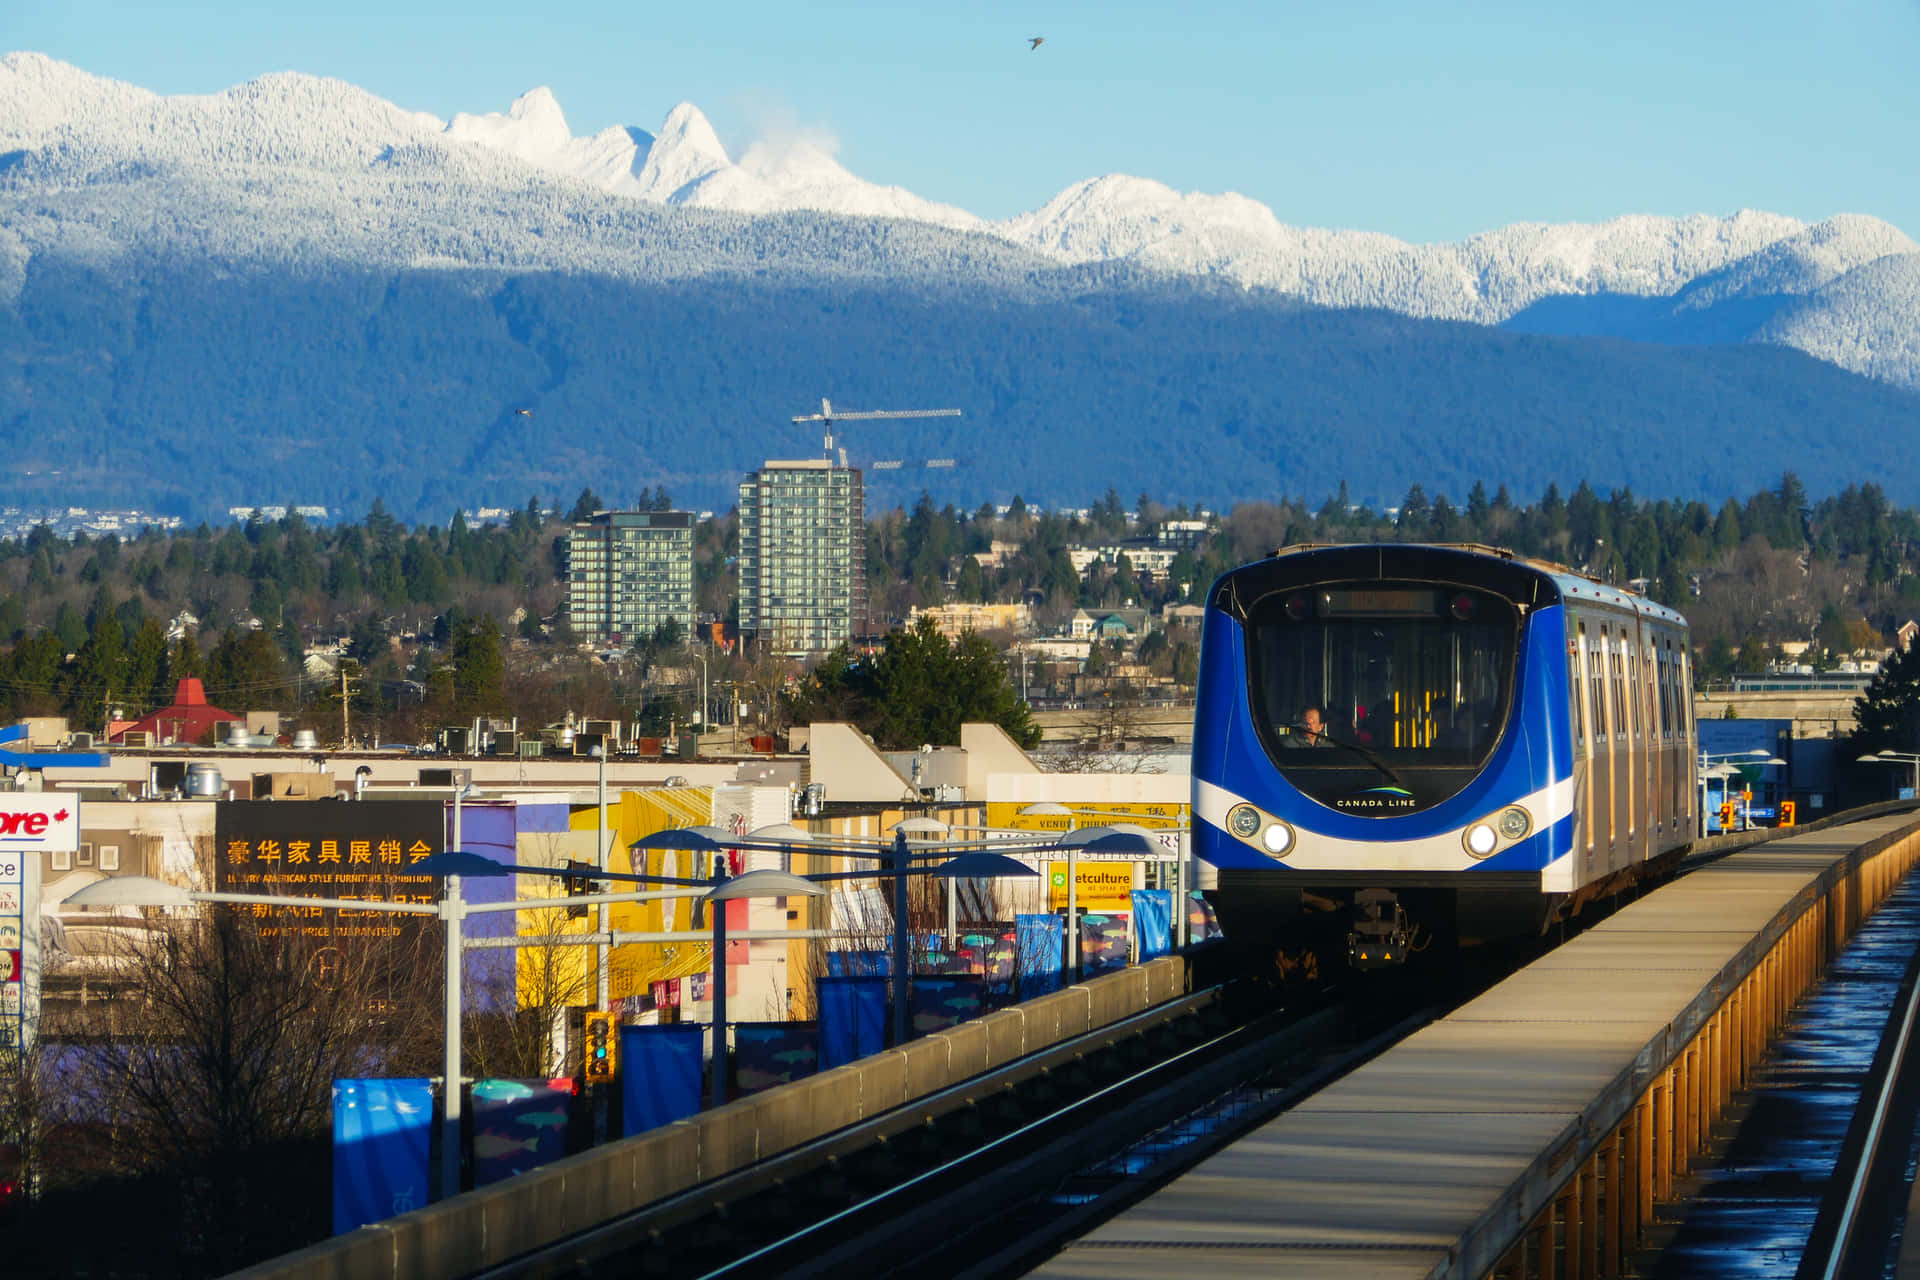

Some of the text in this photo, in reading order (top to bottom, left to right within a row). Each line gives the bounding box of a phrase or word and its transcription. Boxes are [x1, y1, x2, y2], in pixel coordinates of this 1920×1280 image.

[227, 840, 432, 865] 豪华家具展销会
[309, 874, 333, 883] STYLE
[1073, 872, 1130, 884] etculture
[301, 927, 330, 936] PRICE
